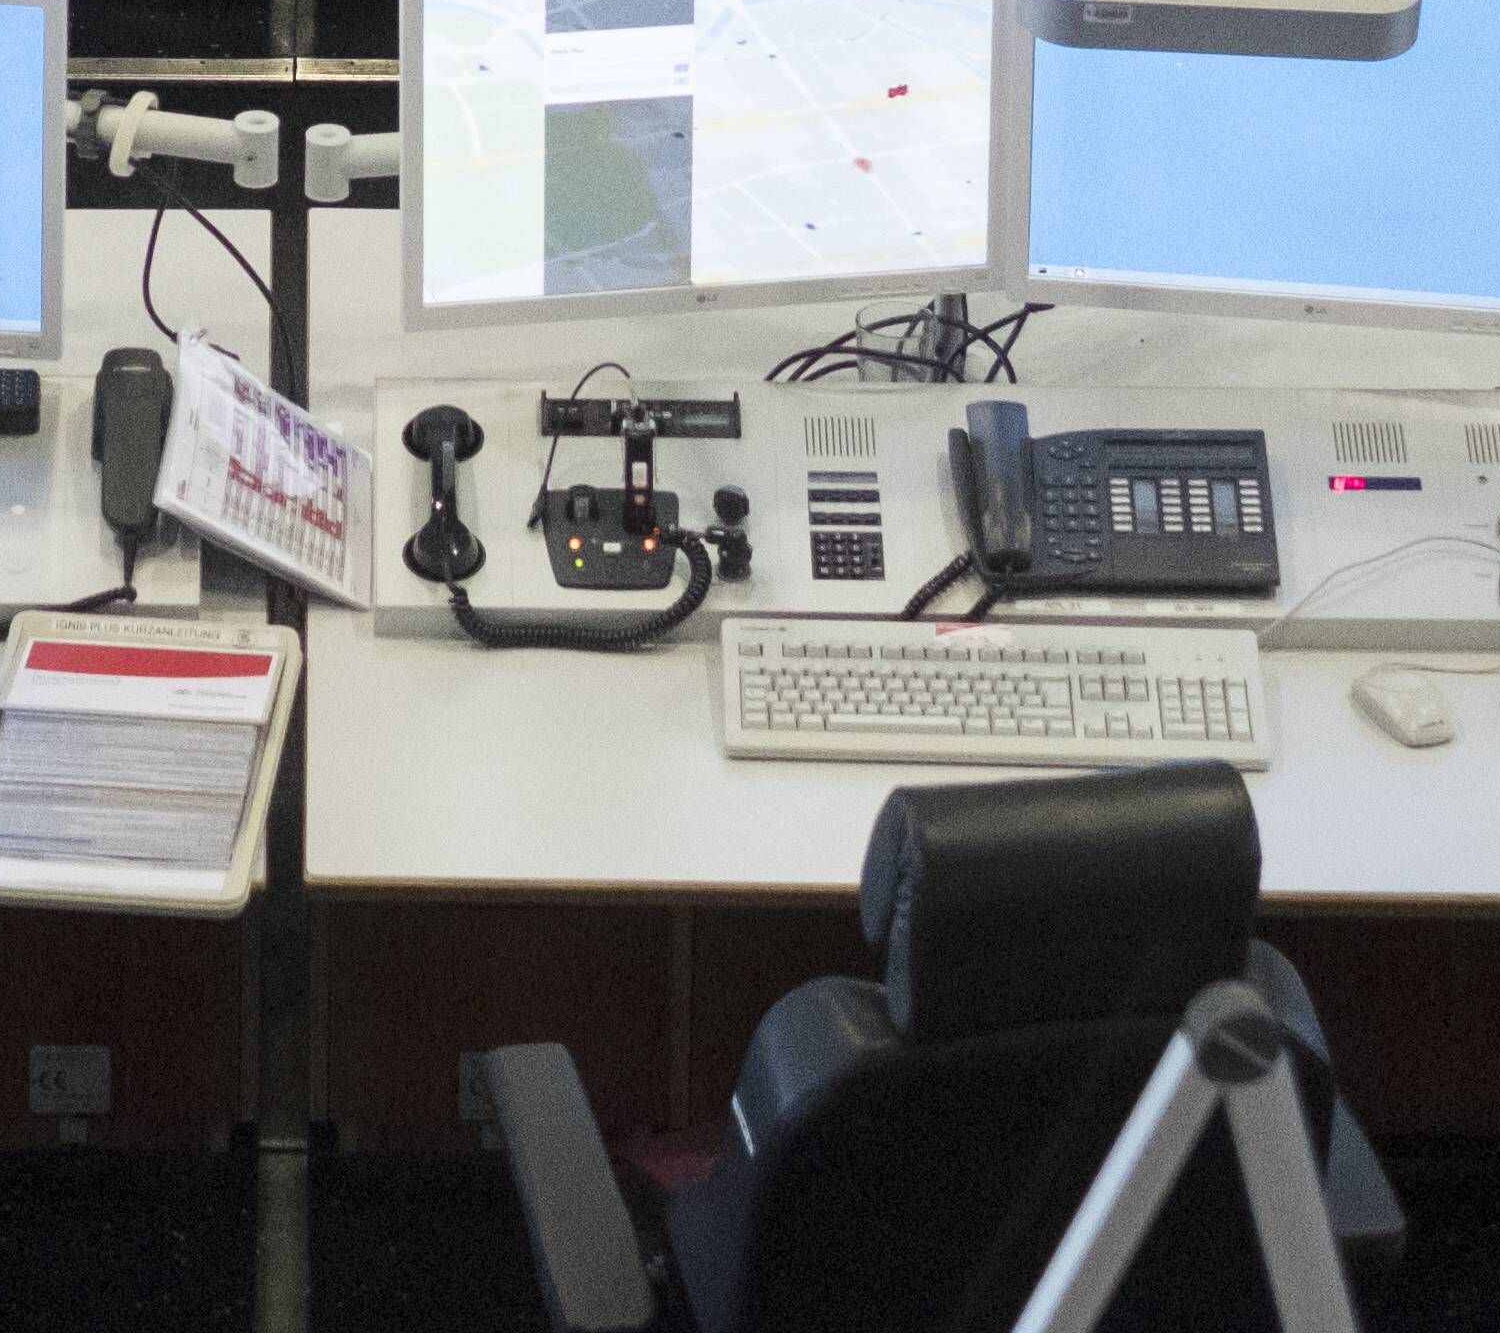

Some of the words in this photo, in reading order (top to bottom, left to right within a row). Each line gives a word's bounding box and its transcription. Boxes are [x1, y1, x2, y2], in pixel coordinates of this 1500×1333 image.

[56, 621, 87, 631] IGNIS
[90, 623, 119, 633] PLUS
[123, 625, 221, 640] KURZANLEITUNG
